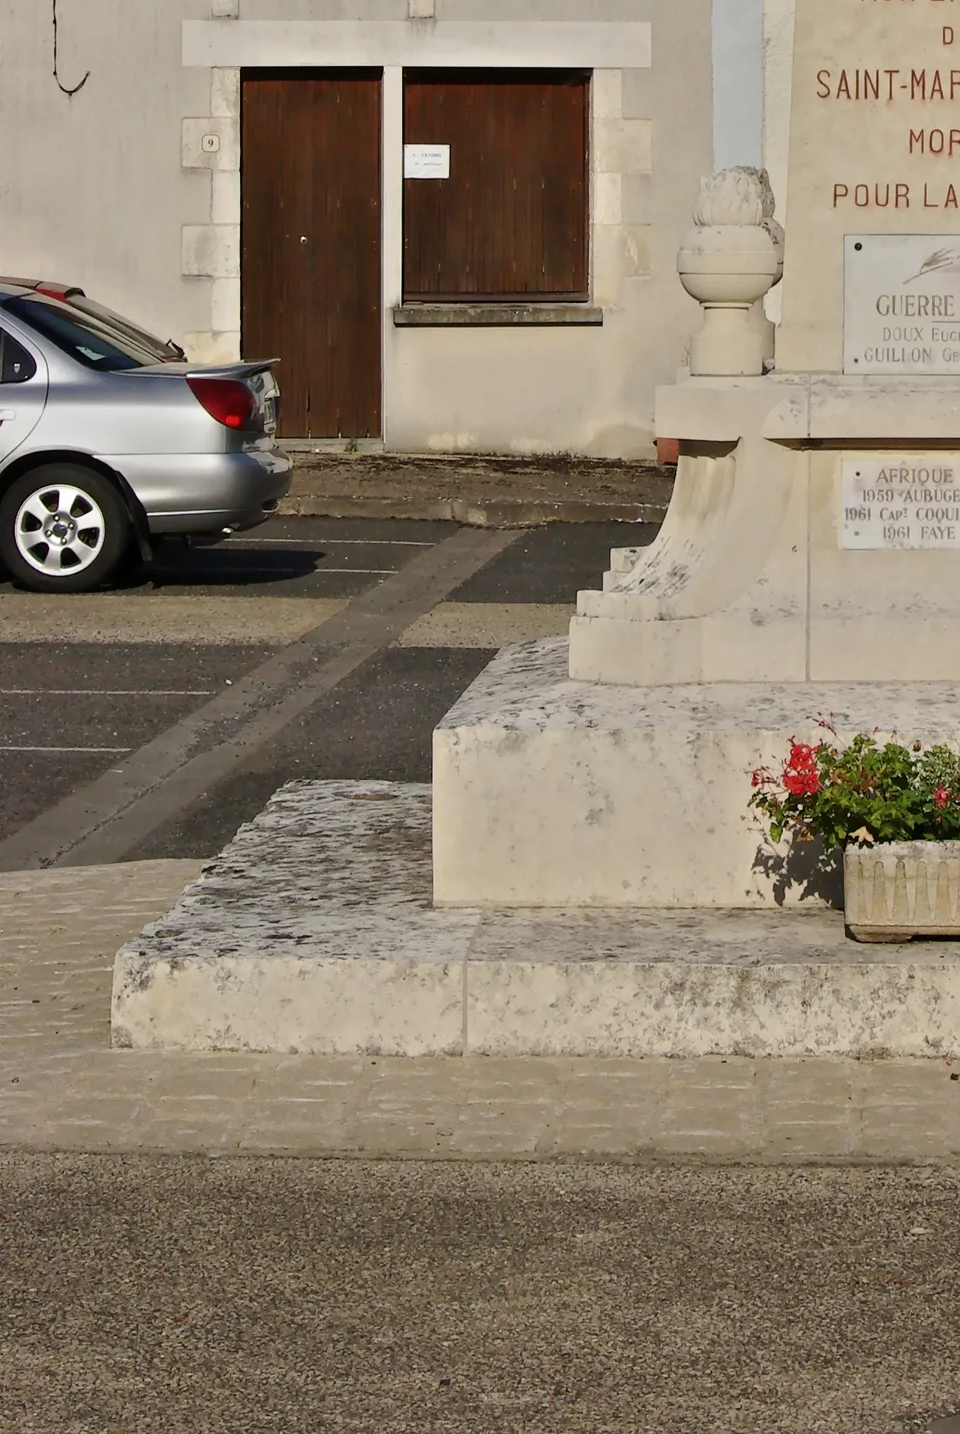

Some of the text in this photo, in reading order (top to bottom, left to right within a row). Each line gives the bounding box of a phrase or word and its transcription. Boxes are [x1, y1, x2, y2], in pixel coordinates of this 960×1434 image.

[207, 138, 214, 148] 9
[832, 183, 910, 209] POUR
[924, 183, 959, 209] LA
[876, 295, 954, 316] GUERRE
[883, 327, 923, 341] DOUX
[865, 348, 932, 363] GUILLON
[876, 469, 953, 485] AFRIQUE
[863, 489, 893, 502] 1959
[844, 508, 871, 520] 1961
[883, 527, 910, 539] 1961
[921, 527, 955, 539] FAYE
